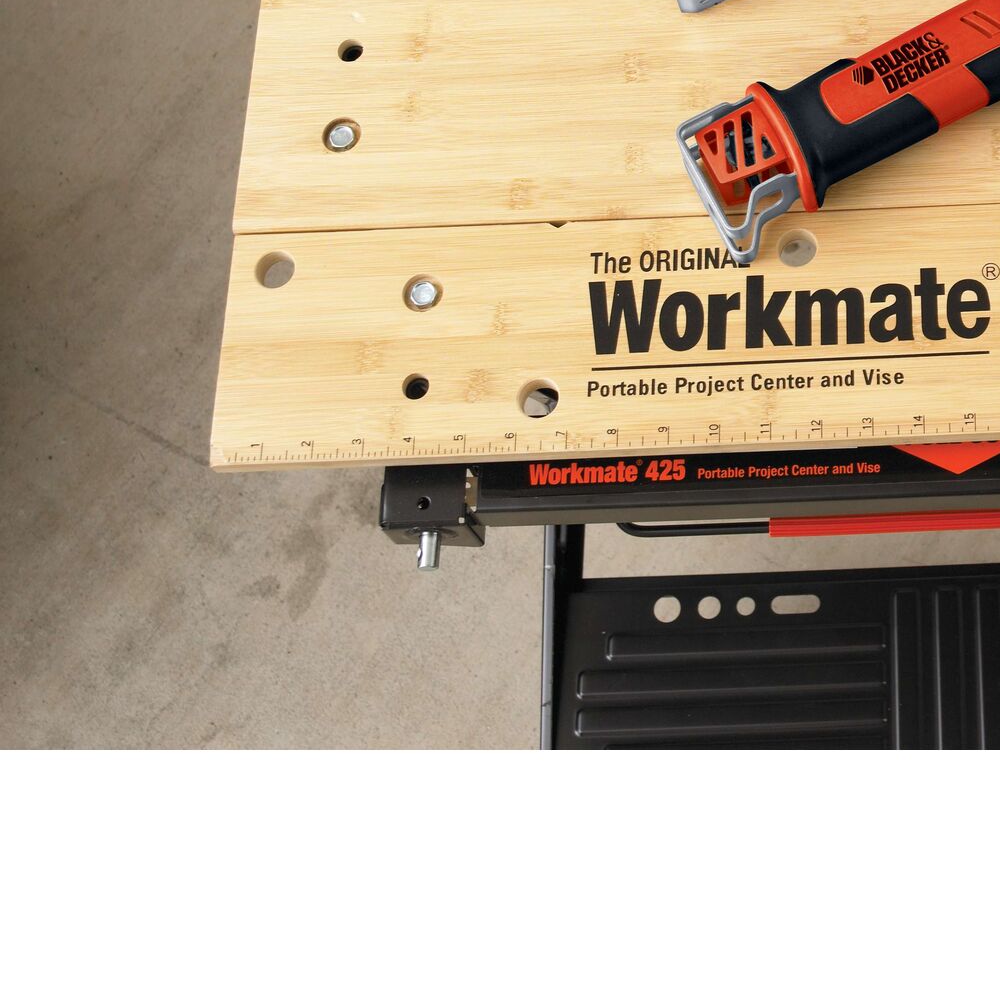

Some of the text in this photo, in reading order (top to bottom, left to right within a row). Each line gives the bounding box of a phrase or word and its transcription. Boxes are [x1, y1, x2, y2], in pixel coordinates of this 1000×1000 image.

[882, 48, 951, 94] DECKER
[590, 251, 632, 275] The
[587, 369, 905, 398] Portable Project Center and Vise
[709, 423, 719, 437] 10
[760, 422, 769, 435] 11
[811, 420, 821, 432] 12
[862, 417, 872, 430] 13
[914, 415, 924, 429] 14
[965, 412, 974, 426] 15
[645, 458, 686, 481] 425
[697, 465, 745, 480] Portable
[748, 464, 789, 480] Project
[791, 463, 829, 477] Center
[831, 462, 854, 475] and
[857, 461, 881, 474] Vise
